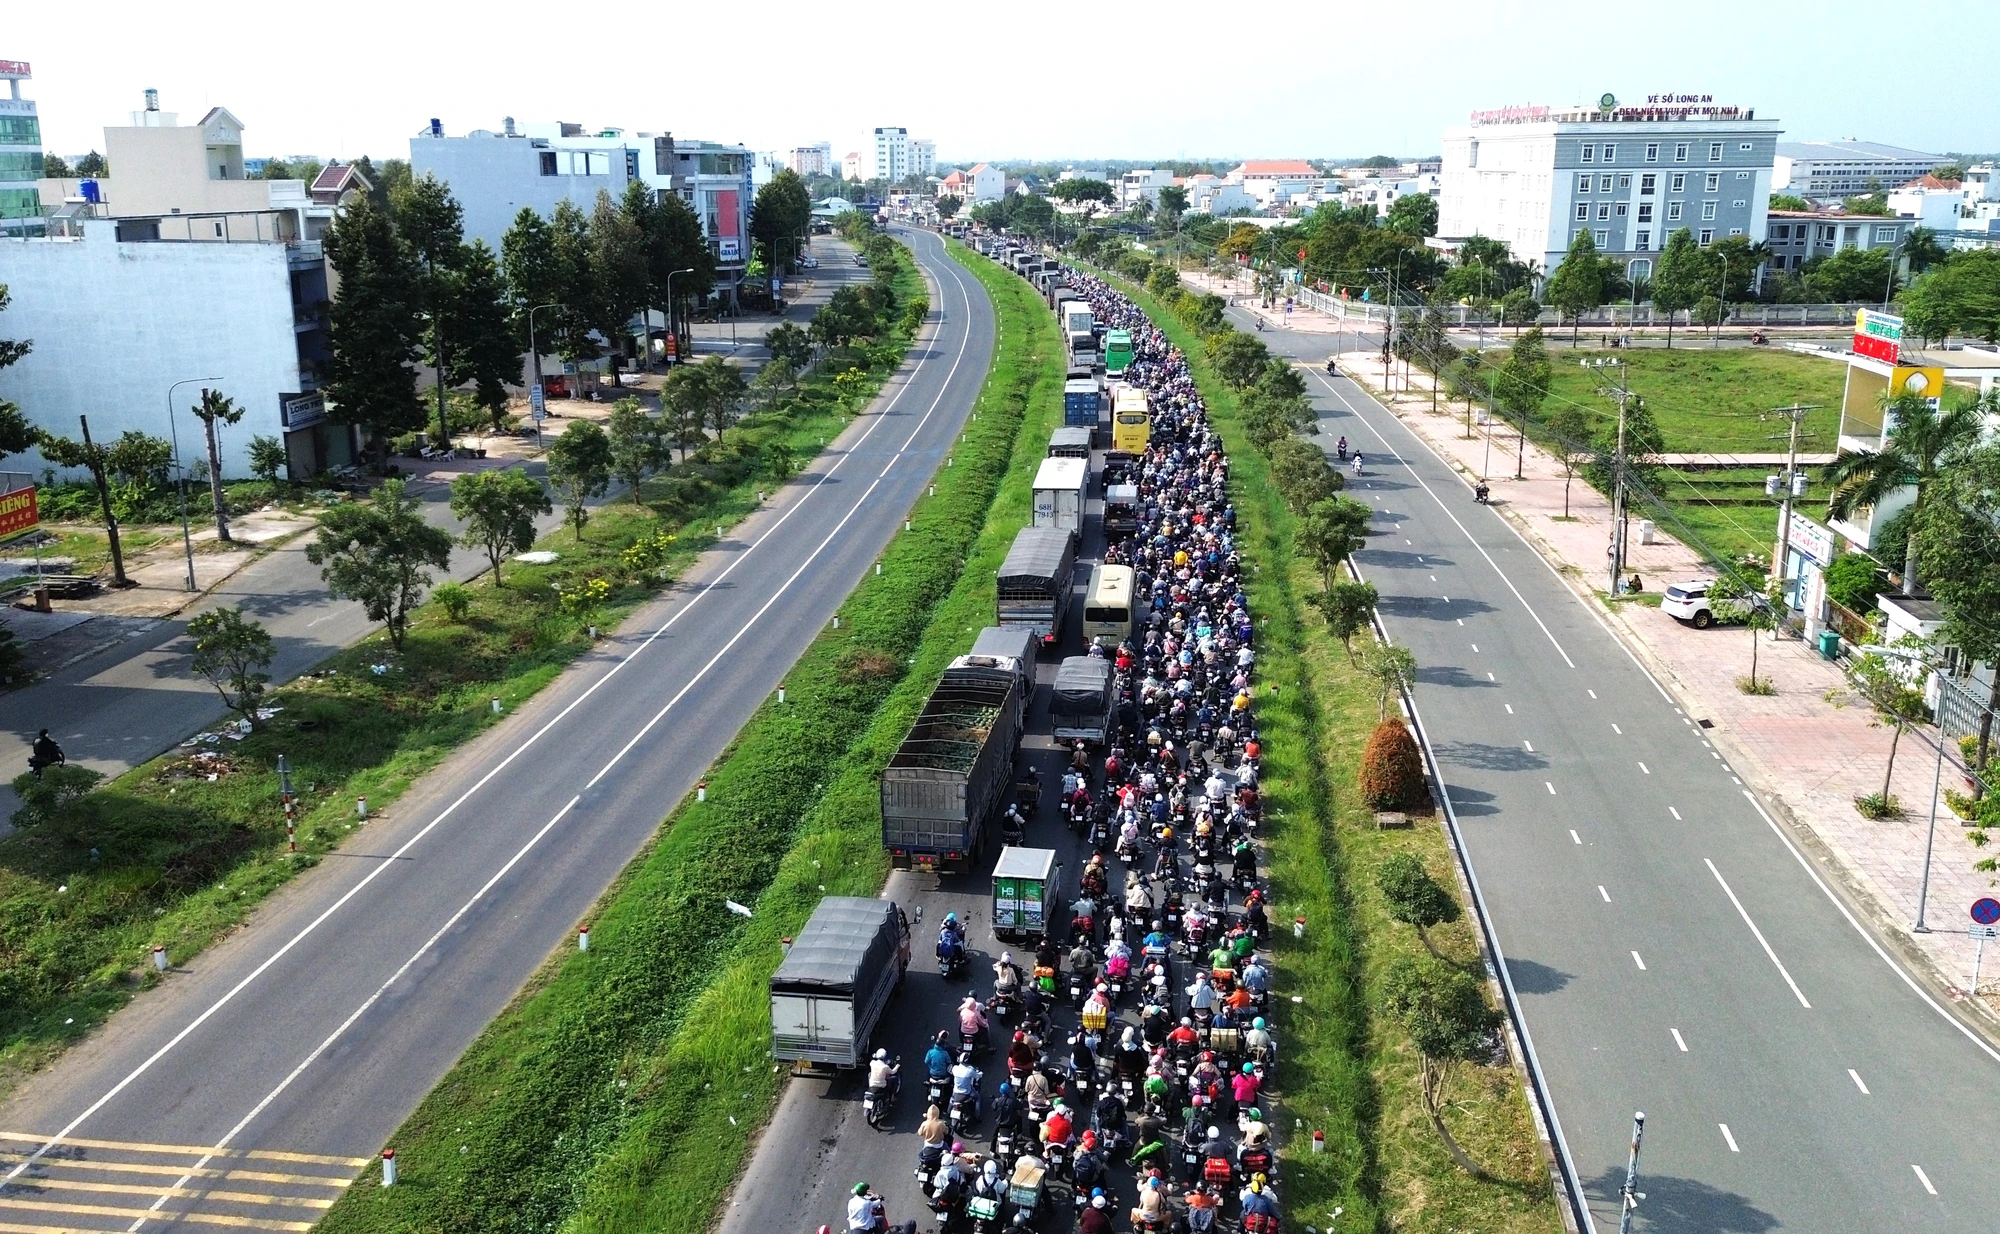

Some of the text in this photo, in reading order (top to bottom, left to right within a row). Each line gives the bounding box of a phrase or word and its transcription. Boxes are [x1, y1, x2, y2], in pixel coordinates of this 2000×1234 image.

[1648, 92, 1713, 103] VÉ SỐ LONG AN
[290, 402, 310, 415] LONG
